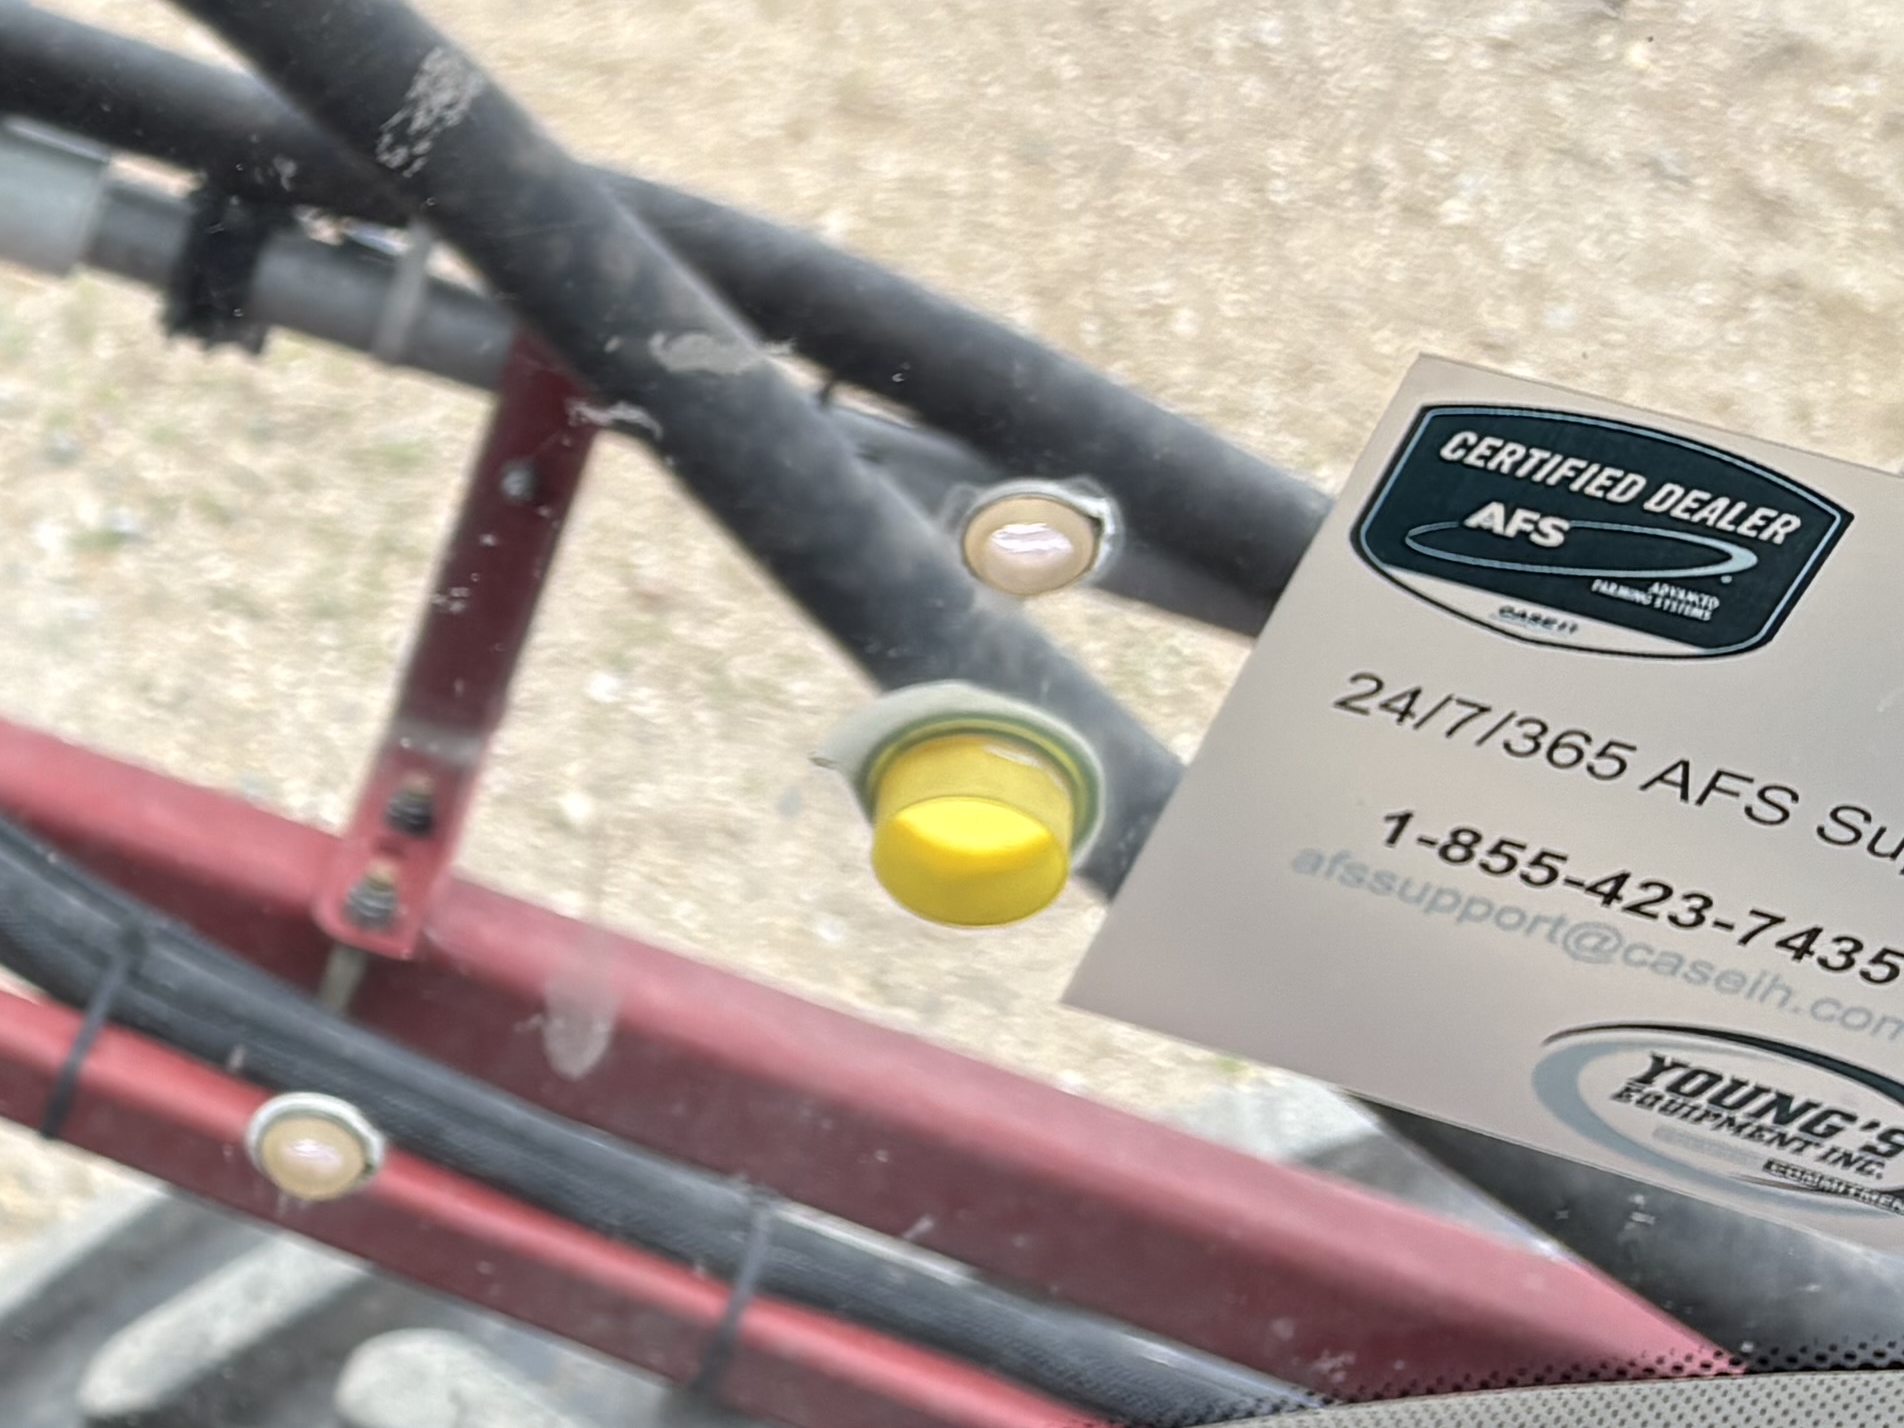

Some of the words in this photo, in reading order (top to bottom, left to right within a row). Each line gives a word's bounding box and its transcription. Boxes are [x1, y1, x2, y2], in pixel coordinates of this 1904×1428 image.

[1439, 430, 1646, 505] CERTIFIED
[1642, 483, 1802, 545] DEALER
[1463, 501, 1571, 548] AFS
[1333, 671, 1638, 782] 24/7/365
[1639, 758, 1800, 827] AFS
[1816, 804, 1904, 877] Su
[1383, 809, 1904, 986] 1-855-423-7435
[1610, 1084, 1820, 1156] EQUIPMENT
